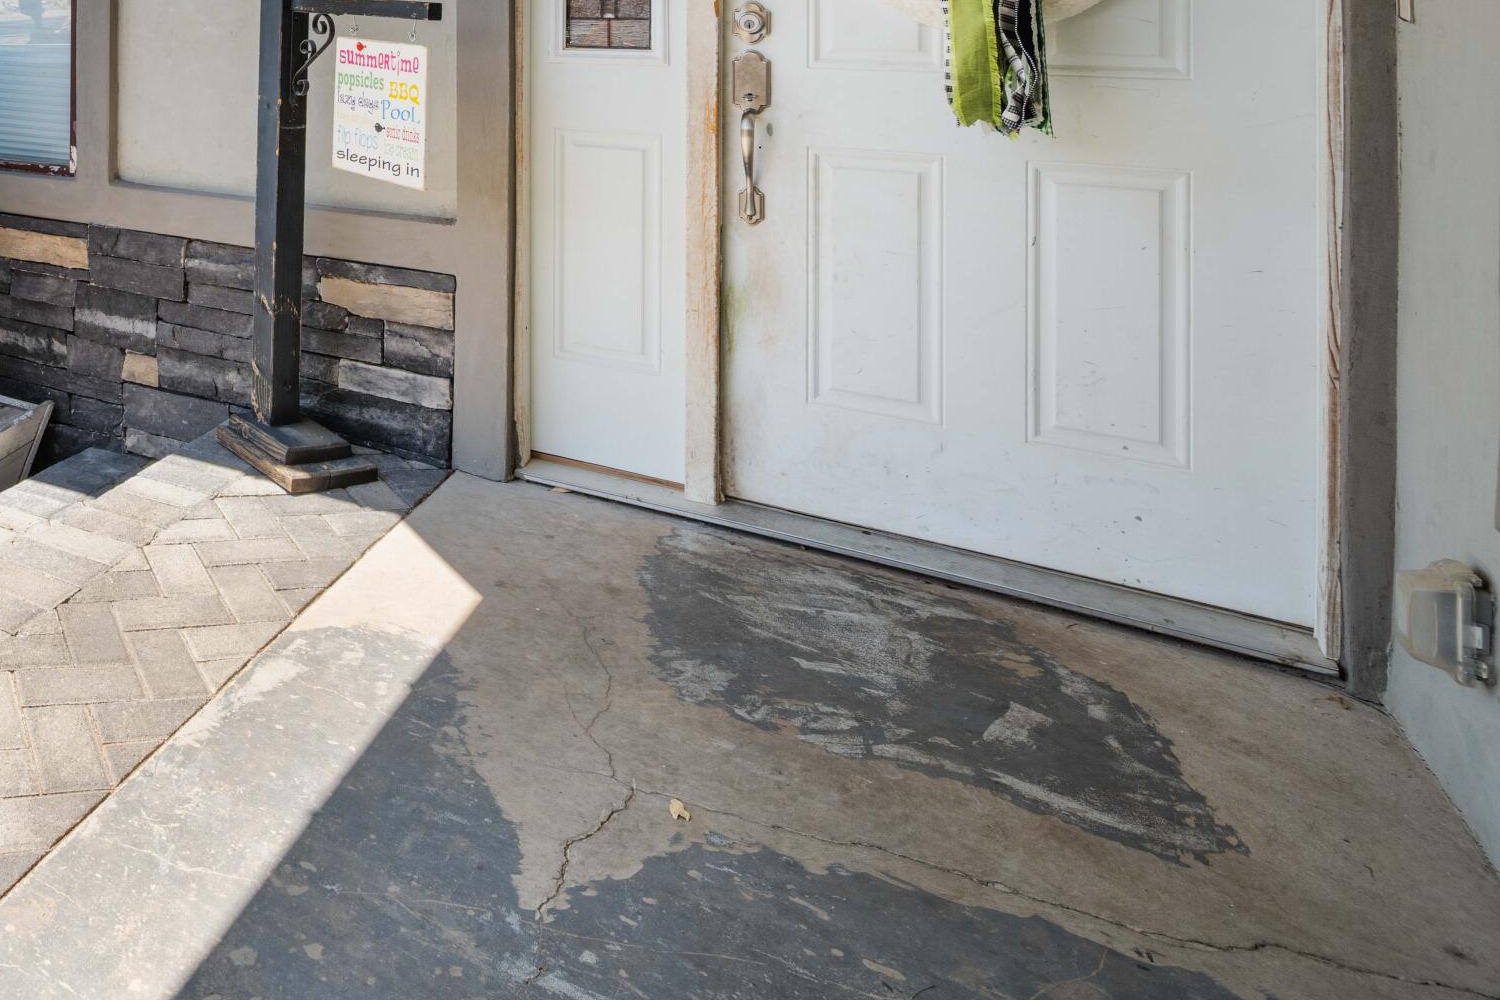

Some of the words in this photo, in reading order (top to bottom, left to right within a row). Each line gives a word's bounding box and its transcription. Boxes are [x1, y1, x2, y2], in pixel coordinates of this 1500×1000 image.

[337, 70, 384, 91] popsicles
[388, 81, 420, 105] BBQ
[336, 148, 401, 176] sleeping
[406, 162, 420, 178] in
